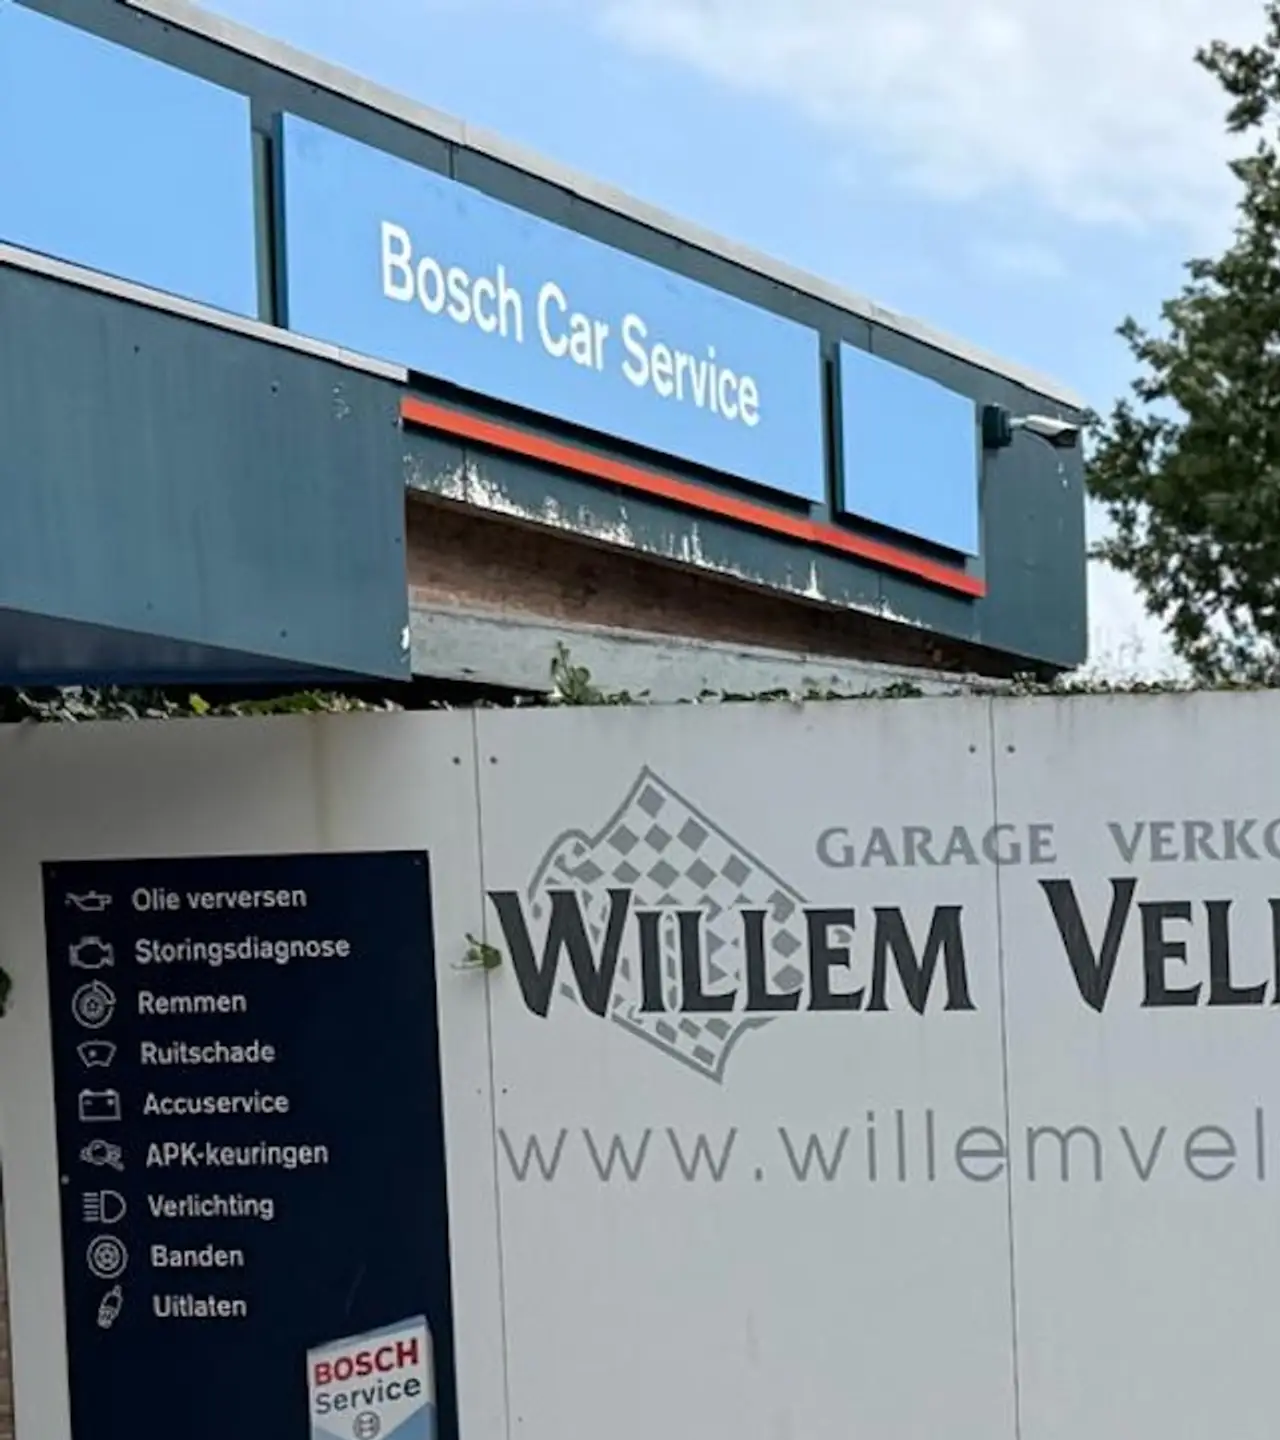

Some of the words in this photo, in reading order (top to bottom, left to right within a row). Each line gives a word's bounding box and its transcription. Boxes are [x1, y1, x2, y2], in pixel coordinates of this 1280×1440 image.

[380, 221, 523, 343] Bosch
[536, 280, 610, 372] Car
[621, 313, 761, 427] Service
[815, 823, 1057, 868] GARAGE
[132, 888, 180, 911] Olie
[186, 887, 307, 909] verversen
[134, 936, 351, 967] Storingsdiagnose
[486, 887, 977, 1019] WILLEM
[138, 991, 247, 1015] Remmen
[140, 1040, 276, 1065] Ruitschade
[143, 1091, 289, 1116] Accuservice
[146, 1140, 329, 1168] APK-keuringen
[147, 1193, 275, 1221] Verlichting
[151, 1245, 245, 1268] Banden
[153, 1295, 247, 1318] Uitlaten
[314, 1338, 420, 1387] BOSCH
[314, 1376, 422, 1415] Service
